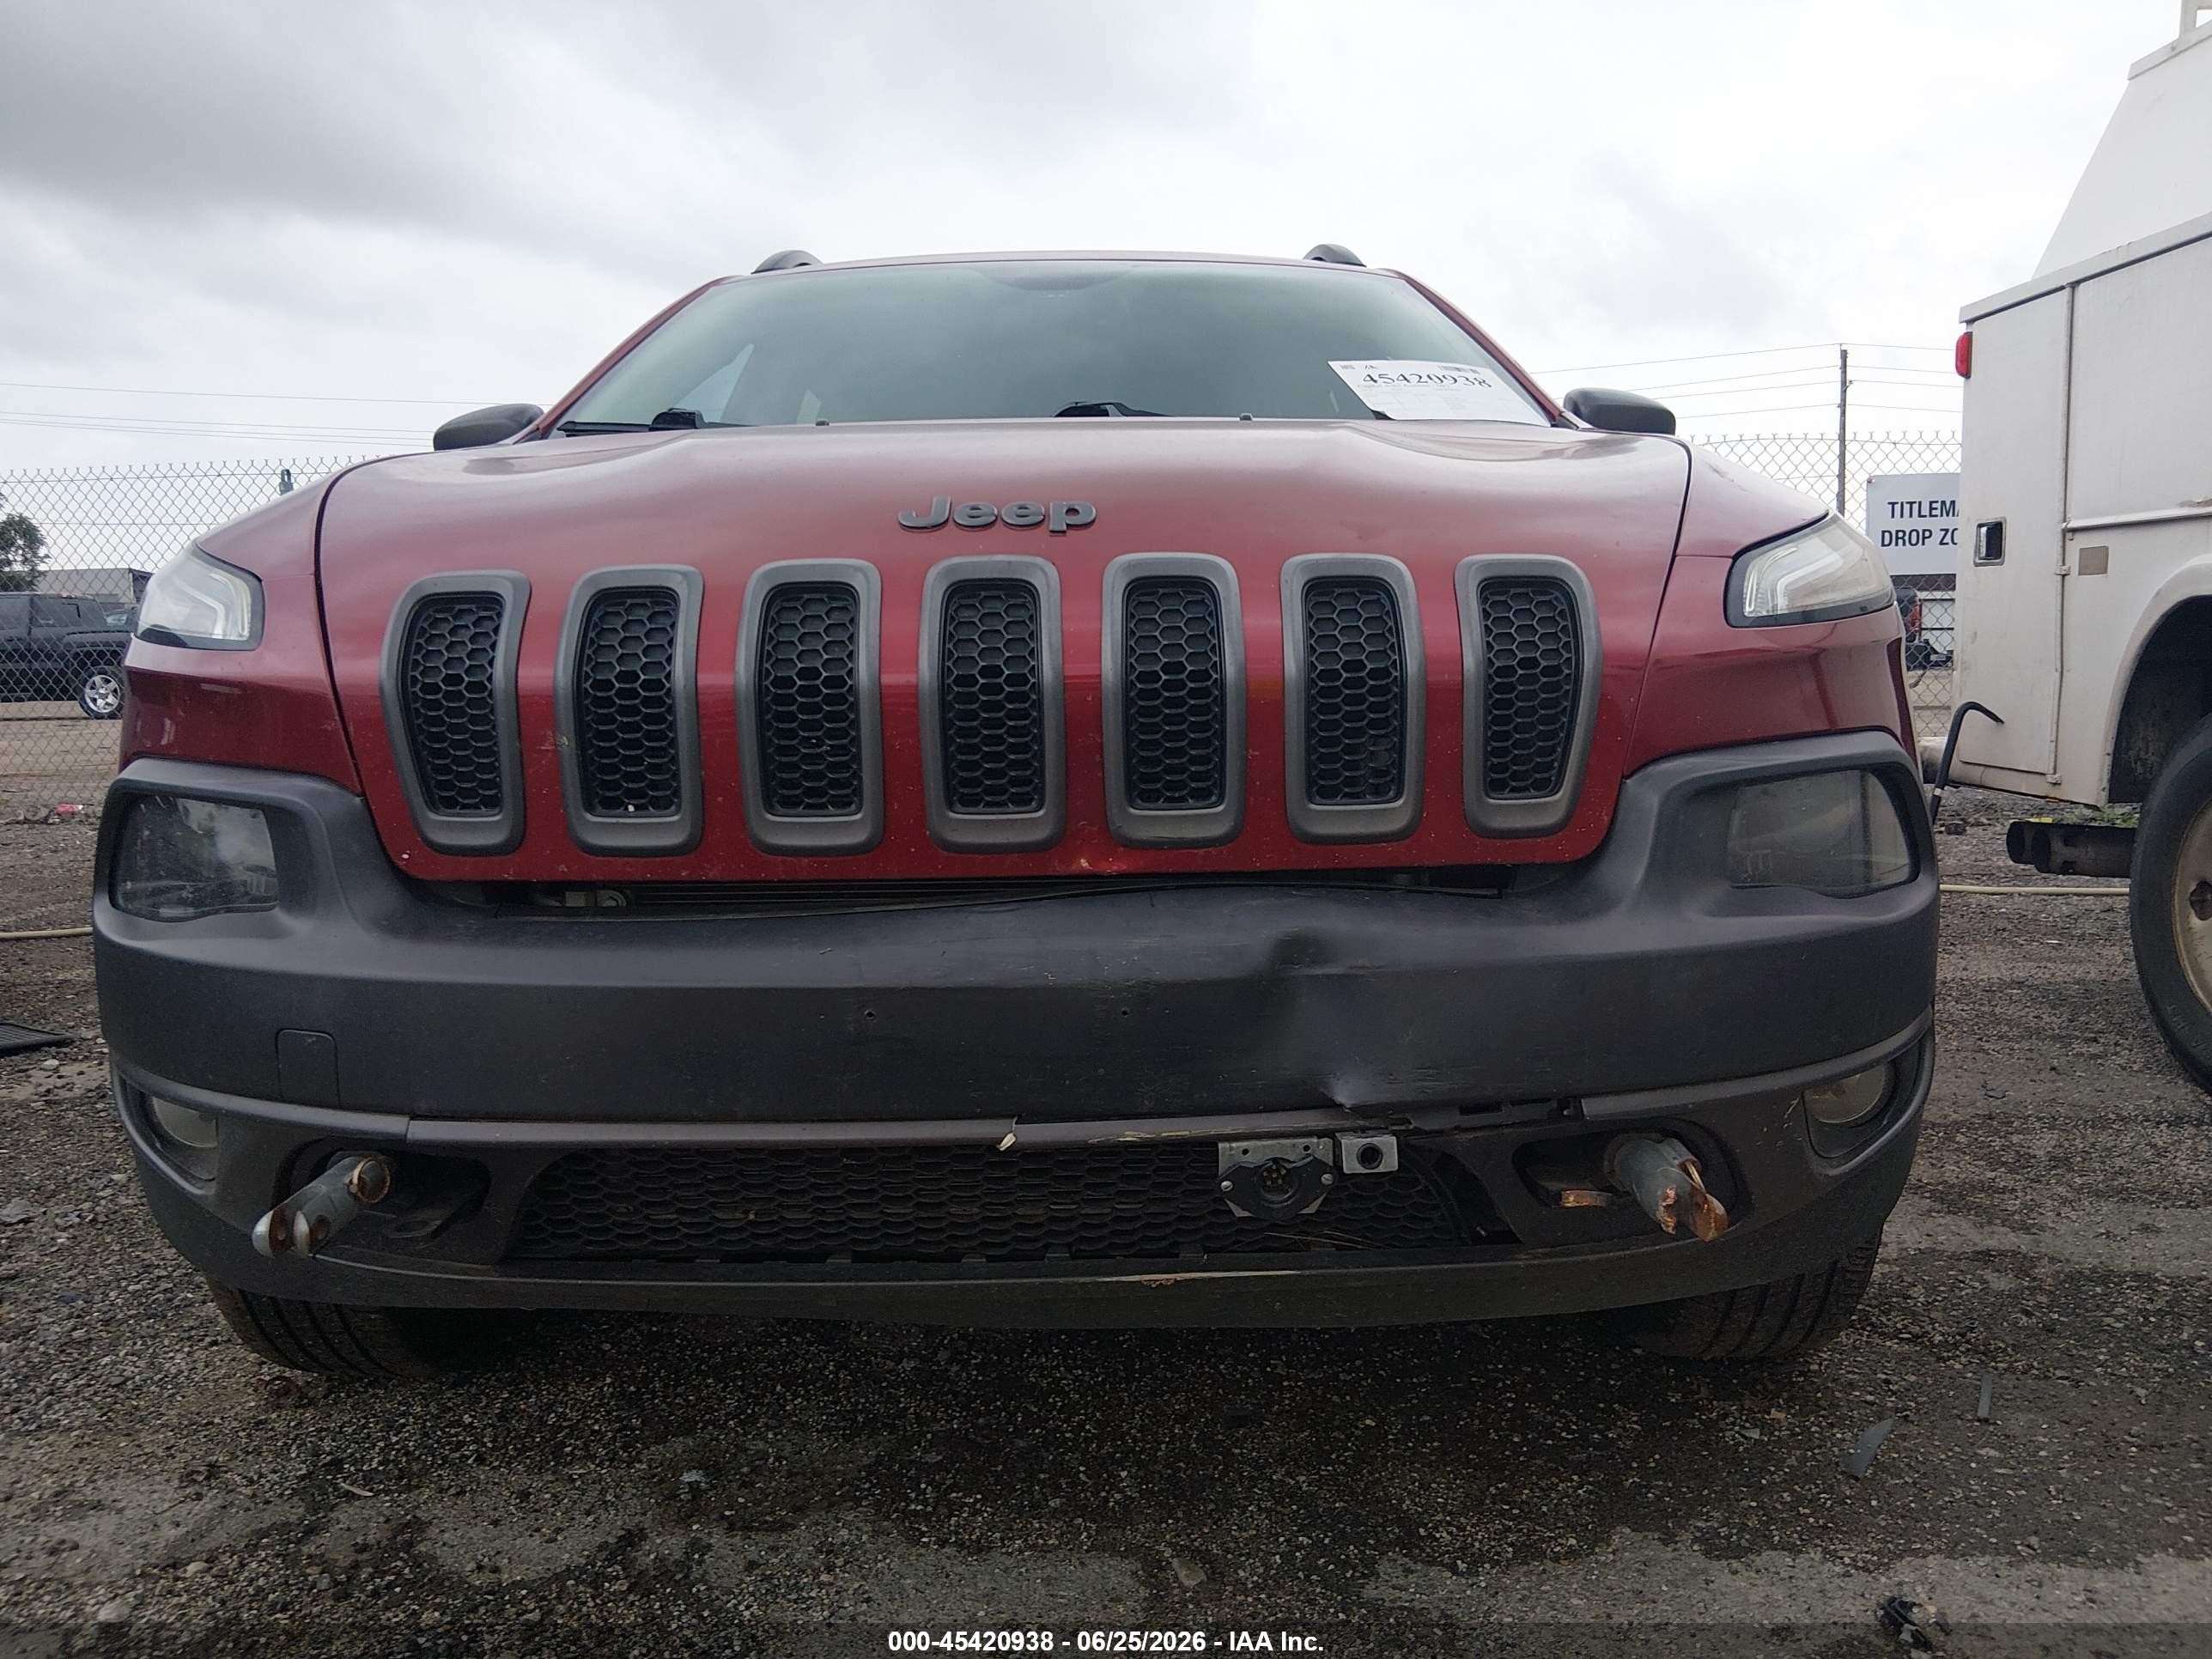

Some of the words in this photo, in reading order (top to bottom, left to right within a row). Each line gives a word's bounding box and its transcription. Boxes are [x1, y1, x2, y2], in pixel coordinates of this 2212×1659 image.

[1363, 372, 1492, 388] 45420938
[898, 495, 1097, 533] Jeep
[1887, 500, 1959, 519] TITLEM
[1881, 528, 1933, 547] DROP
